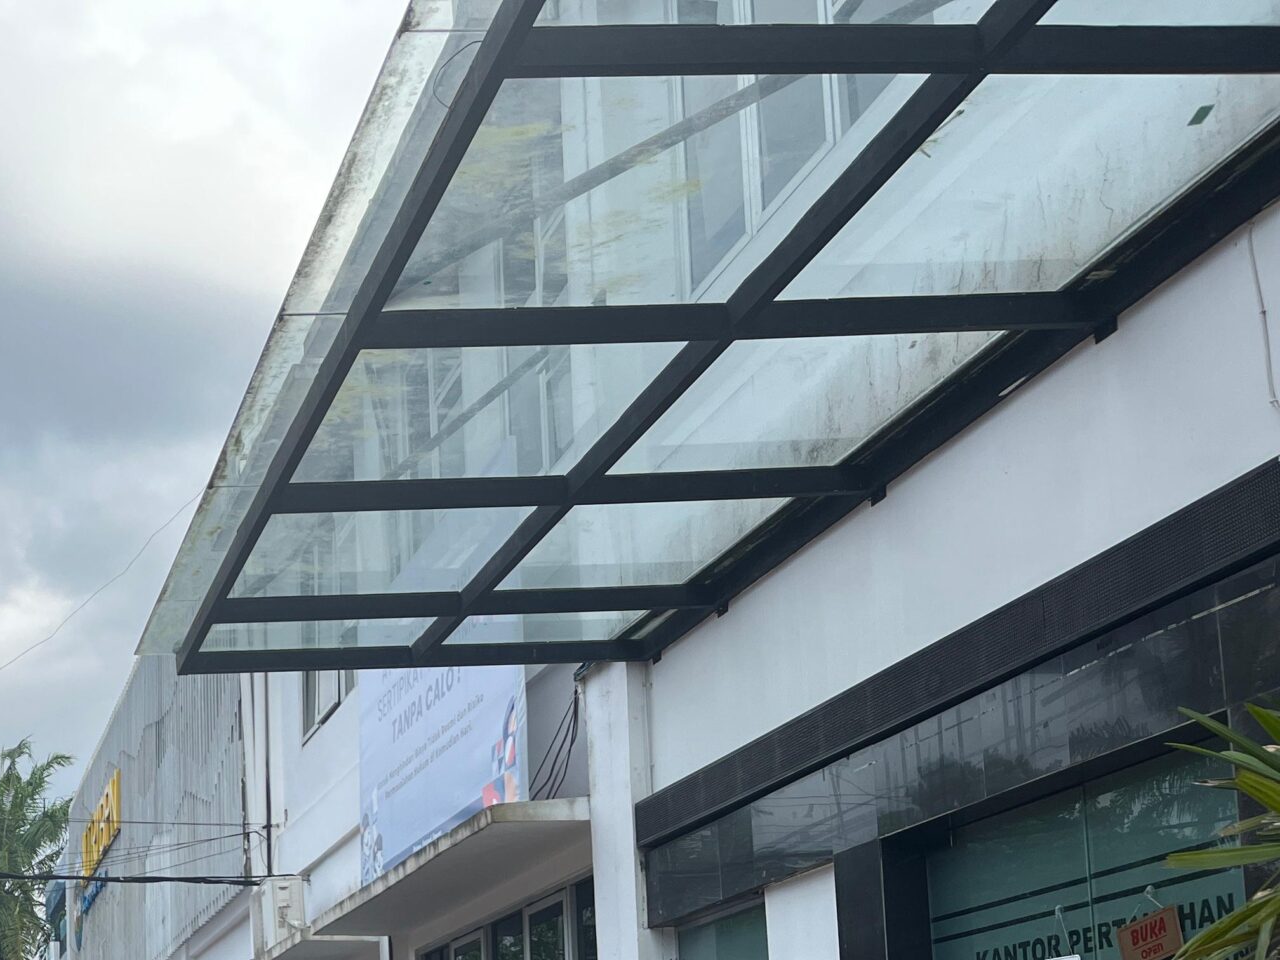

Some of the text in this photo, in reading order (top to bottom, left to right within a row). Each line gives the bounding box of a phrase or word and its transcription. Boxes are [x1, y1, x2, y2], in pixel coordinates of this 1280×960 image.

[392, 695, 423, 744] TANPA
[1130, 917, 1167, 946] BUKA
[1141, 942, 1164, 960] OPEN
